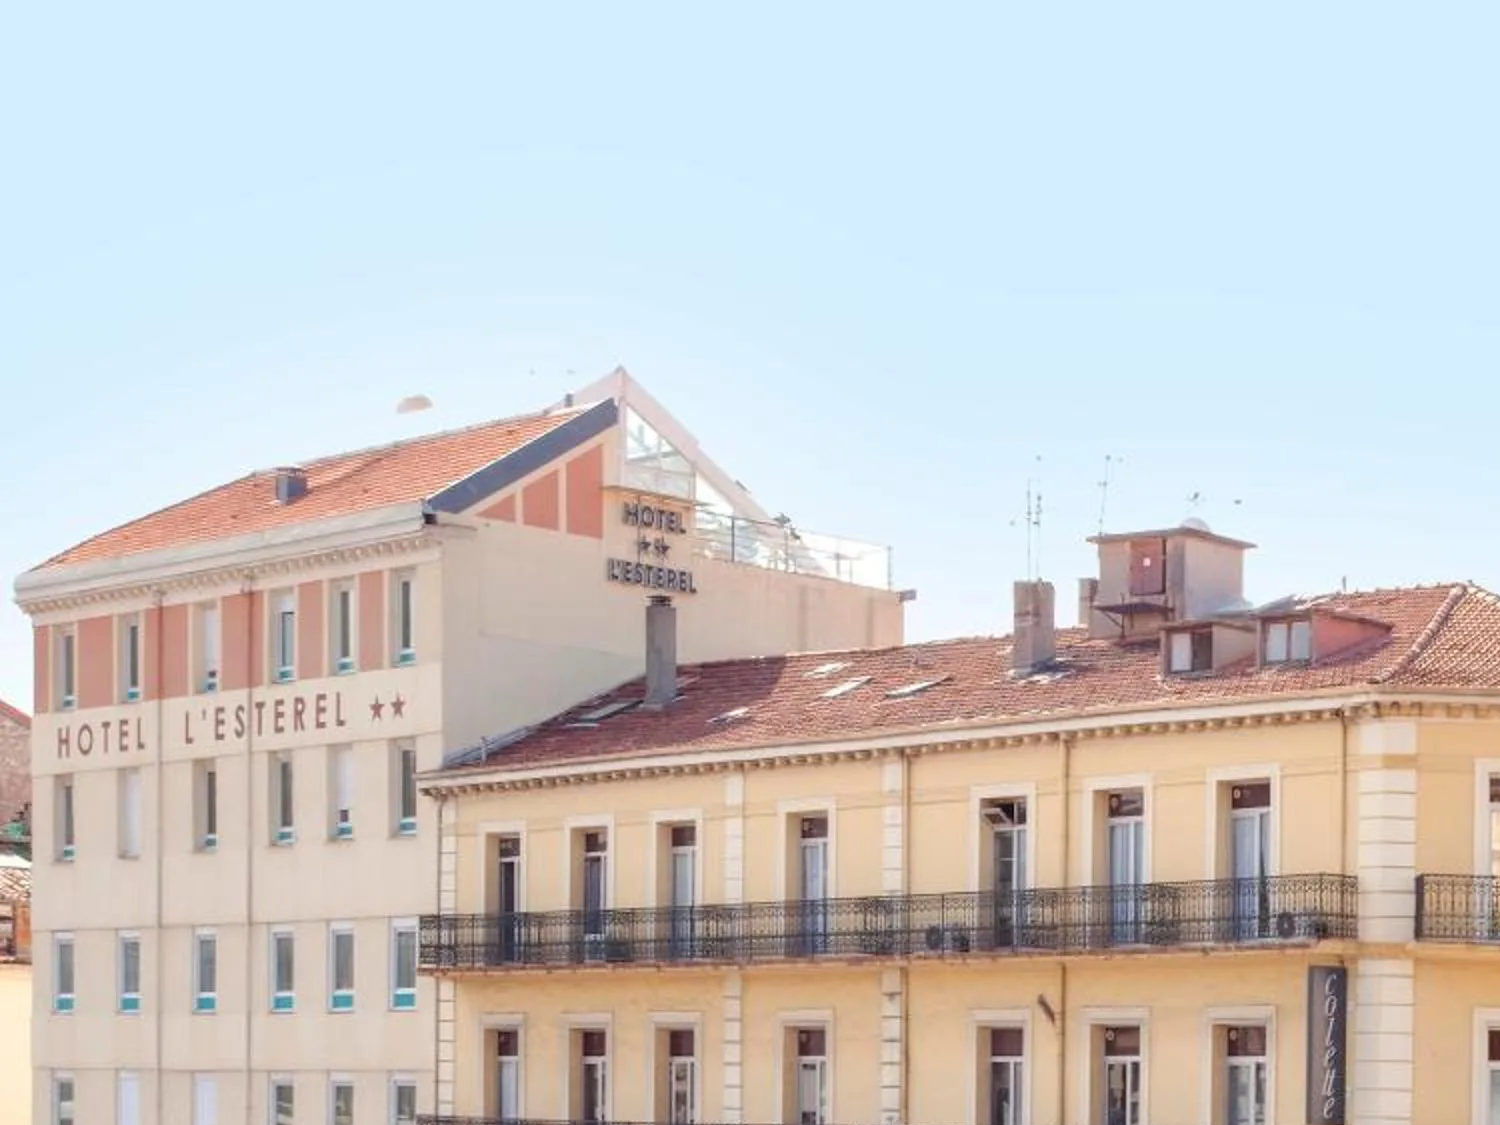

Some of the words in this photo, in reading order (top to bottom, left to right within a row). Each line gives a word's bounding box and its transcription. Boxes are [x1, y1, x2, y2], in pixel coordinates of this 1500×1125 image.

[622, 501, 687, 534] HOTEL
[607, 558, 697, 593] L'ESTEREL
[57, 717, 145, 759] HOTEL
[184, 692, 347, 745] L'ESTEREL
